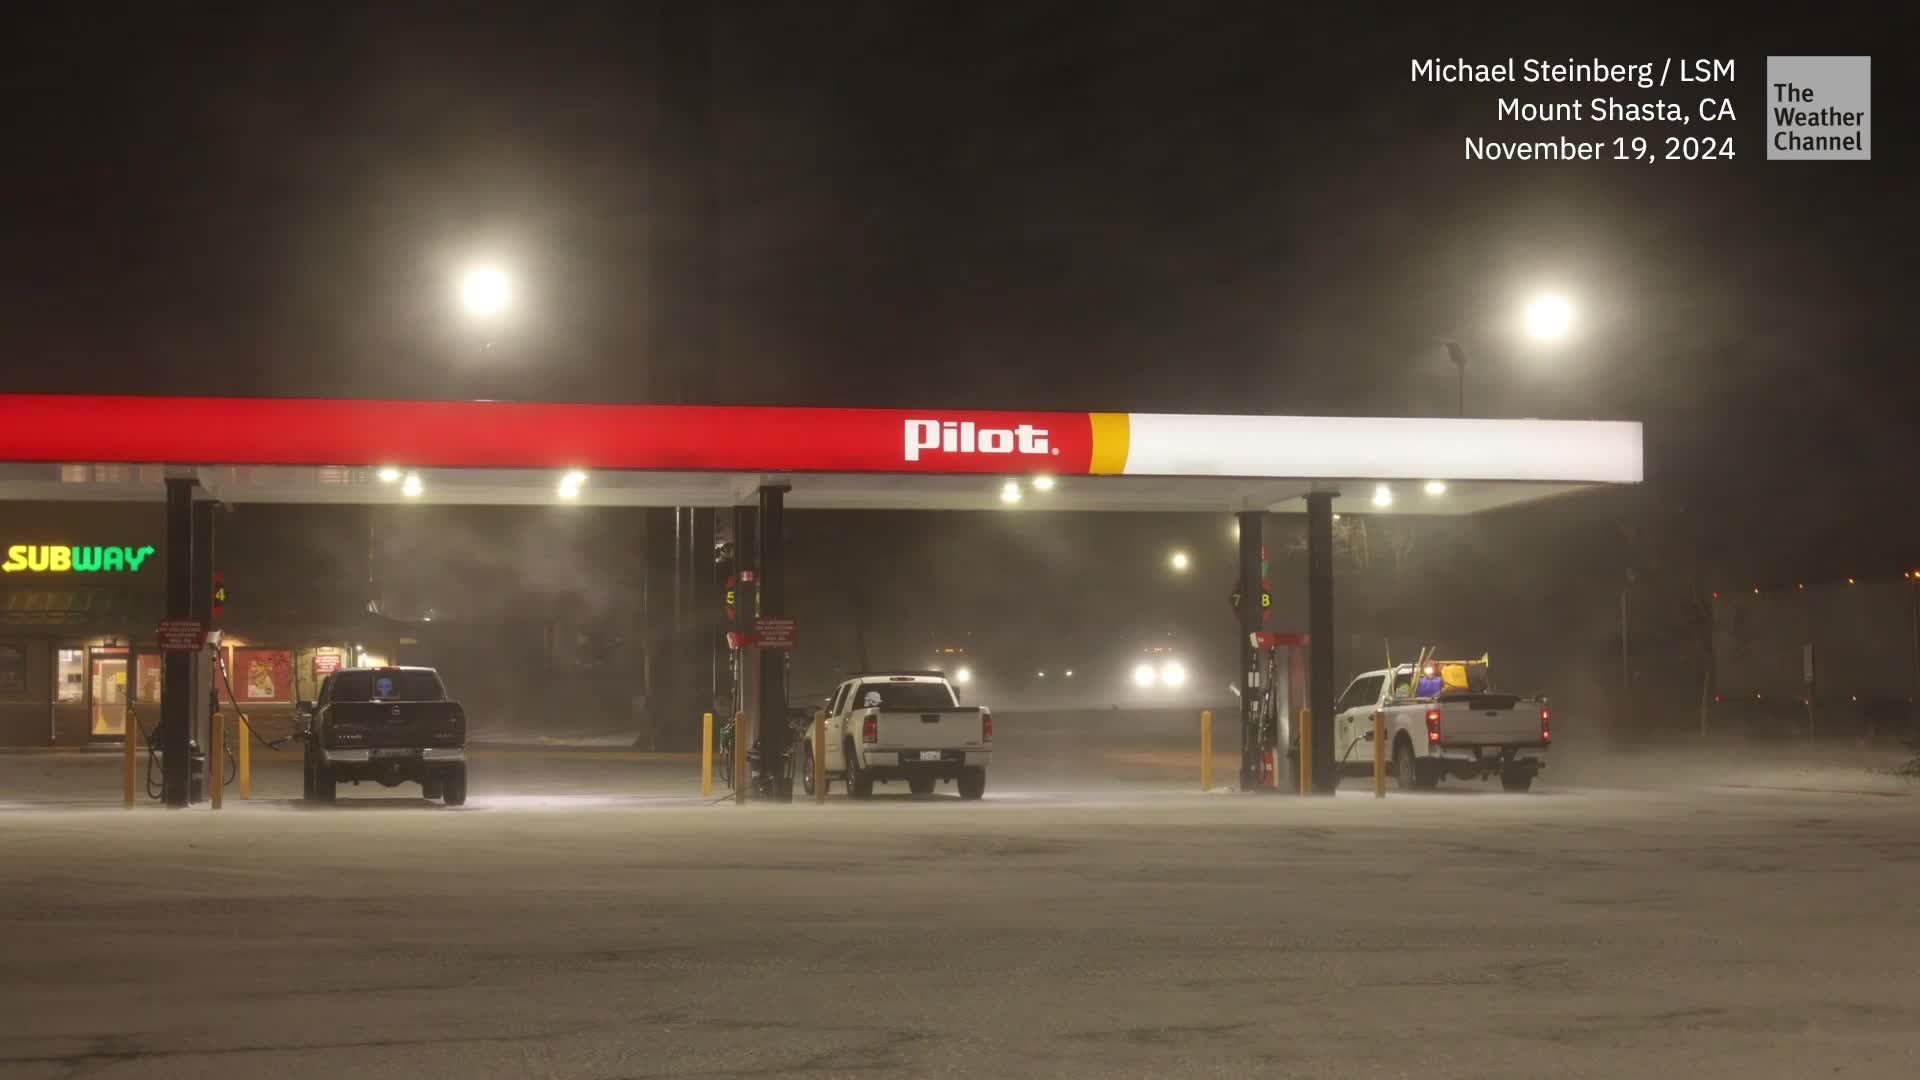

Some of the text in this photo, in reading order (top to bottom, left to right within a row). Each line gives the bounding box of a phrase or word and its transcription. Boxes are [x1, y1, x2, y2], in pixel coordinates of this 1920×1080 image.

[904, 419, 1049, 461] Pilot
[2, 545, 155, 572] SUBWAY
[215, 588, 225, 601] 4
[726, 591, 735, 604] 5
